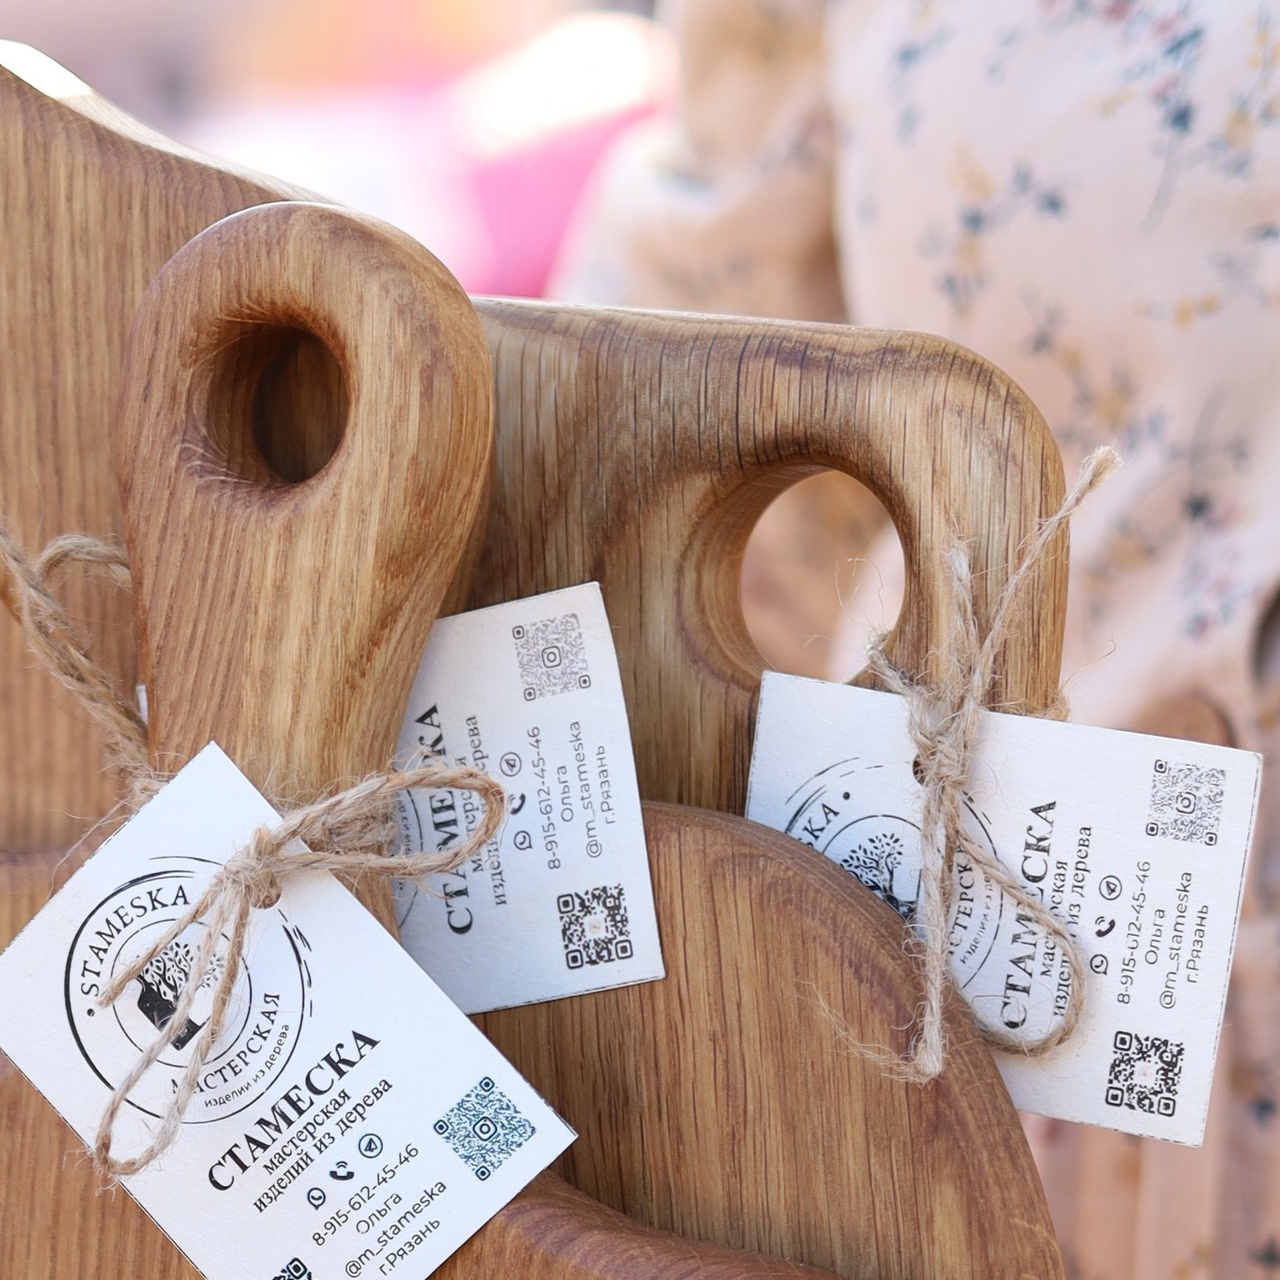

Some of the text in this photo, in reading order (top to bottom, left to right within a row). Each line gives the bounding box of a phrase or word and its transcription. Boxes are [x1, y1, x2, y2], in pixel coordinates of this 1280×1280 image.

[465, 714, 490, 777] ерева
[569, 720, 603, 858] @m_stameska
[594, 745, 616, 825] г.Рязань
[414, 702, 474, 935] СТМЕКА
[526, 725, 561, 870] 8-915-612-45-46
[556, 765, 574, 823] Ольга
[1071, 825, 1093, 899] дерева
[81, 884, 191, 997] STAMESKA
[1116, 860, 1151, 1005] 8-915-612-45-46
[1144, 908, 1166, 966] Ольга
[1158, 870, 1193, 1010] @m_stameska
[1186, 903, 1210, 984] г.Рязань
[252, 1068, 266, 1084] из
[266, 1023, 290, 1071] дерева
[208, 1029, 381, 1191] СТАМЕСКА
[252, 1076, 393, 1214] изделий из дерева
[261, 1087, 352, 1176] мастерская
[311, 1142, 419, 1247] 8-915-612-45-46
[344, 1179, 448, 1279] @m_stameska
[355, 1192, 403, 1235] Ольга
[378, 1217, 441, 1277] г.Рязань
